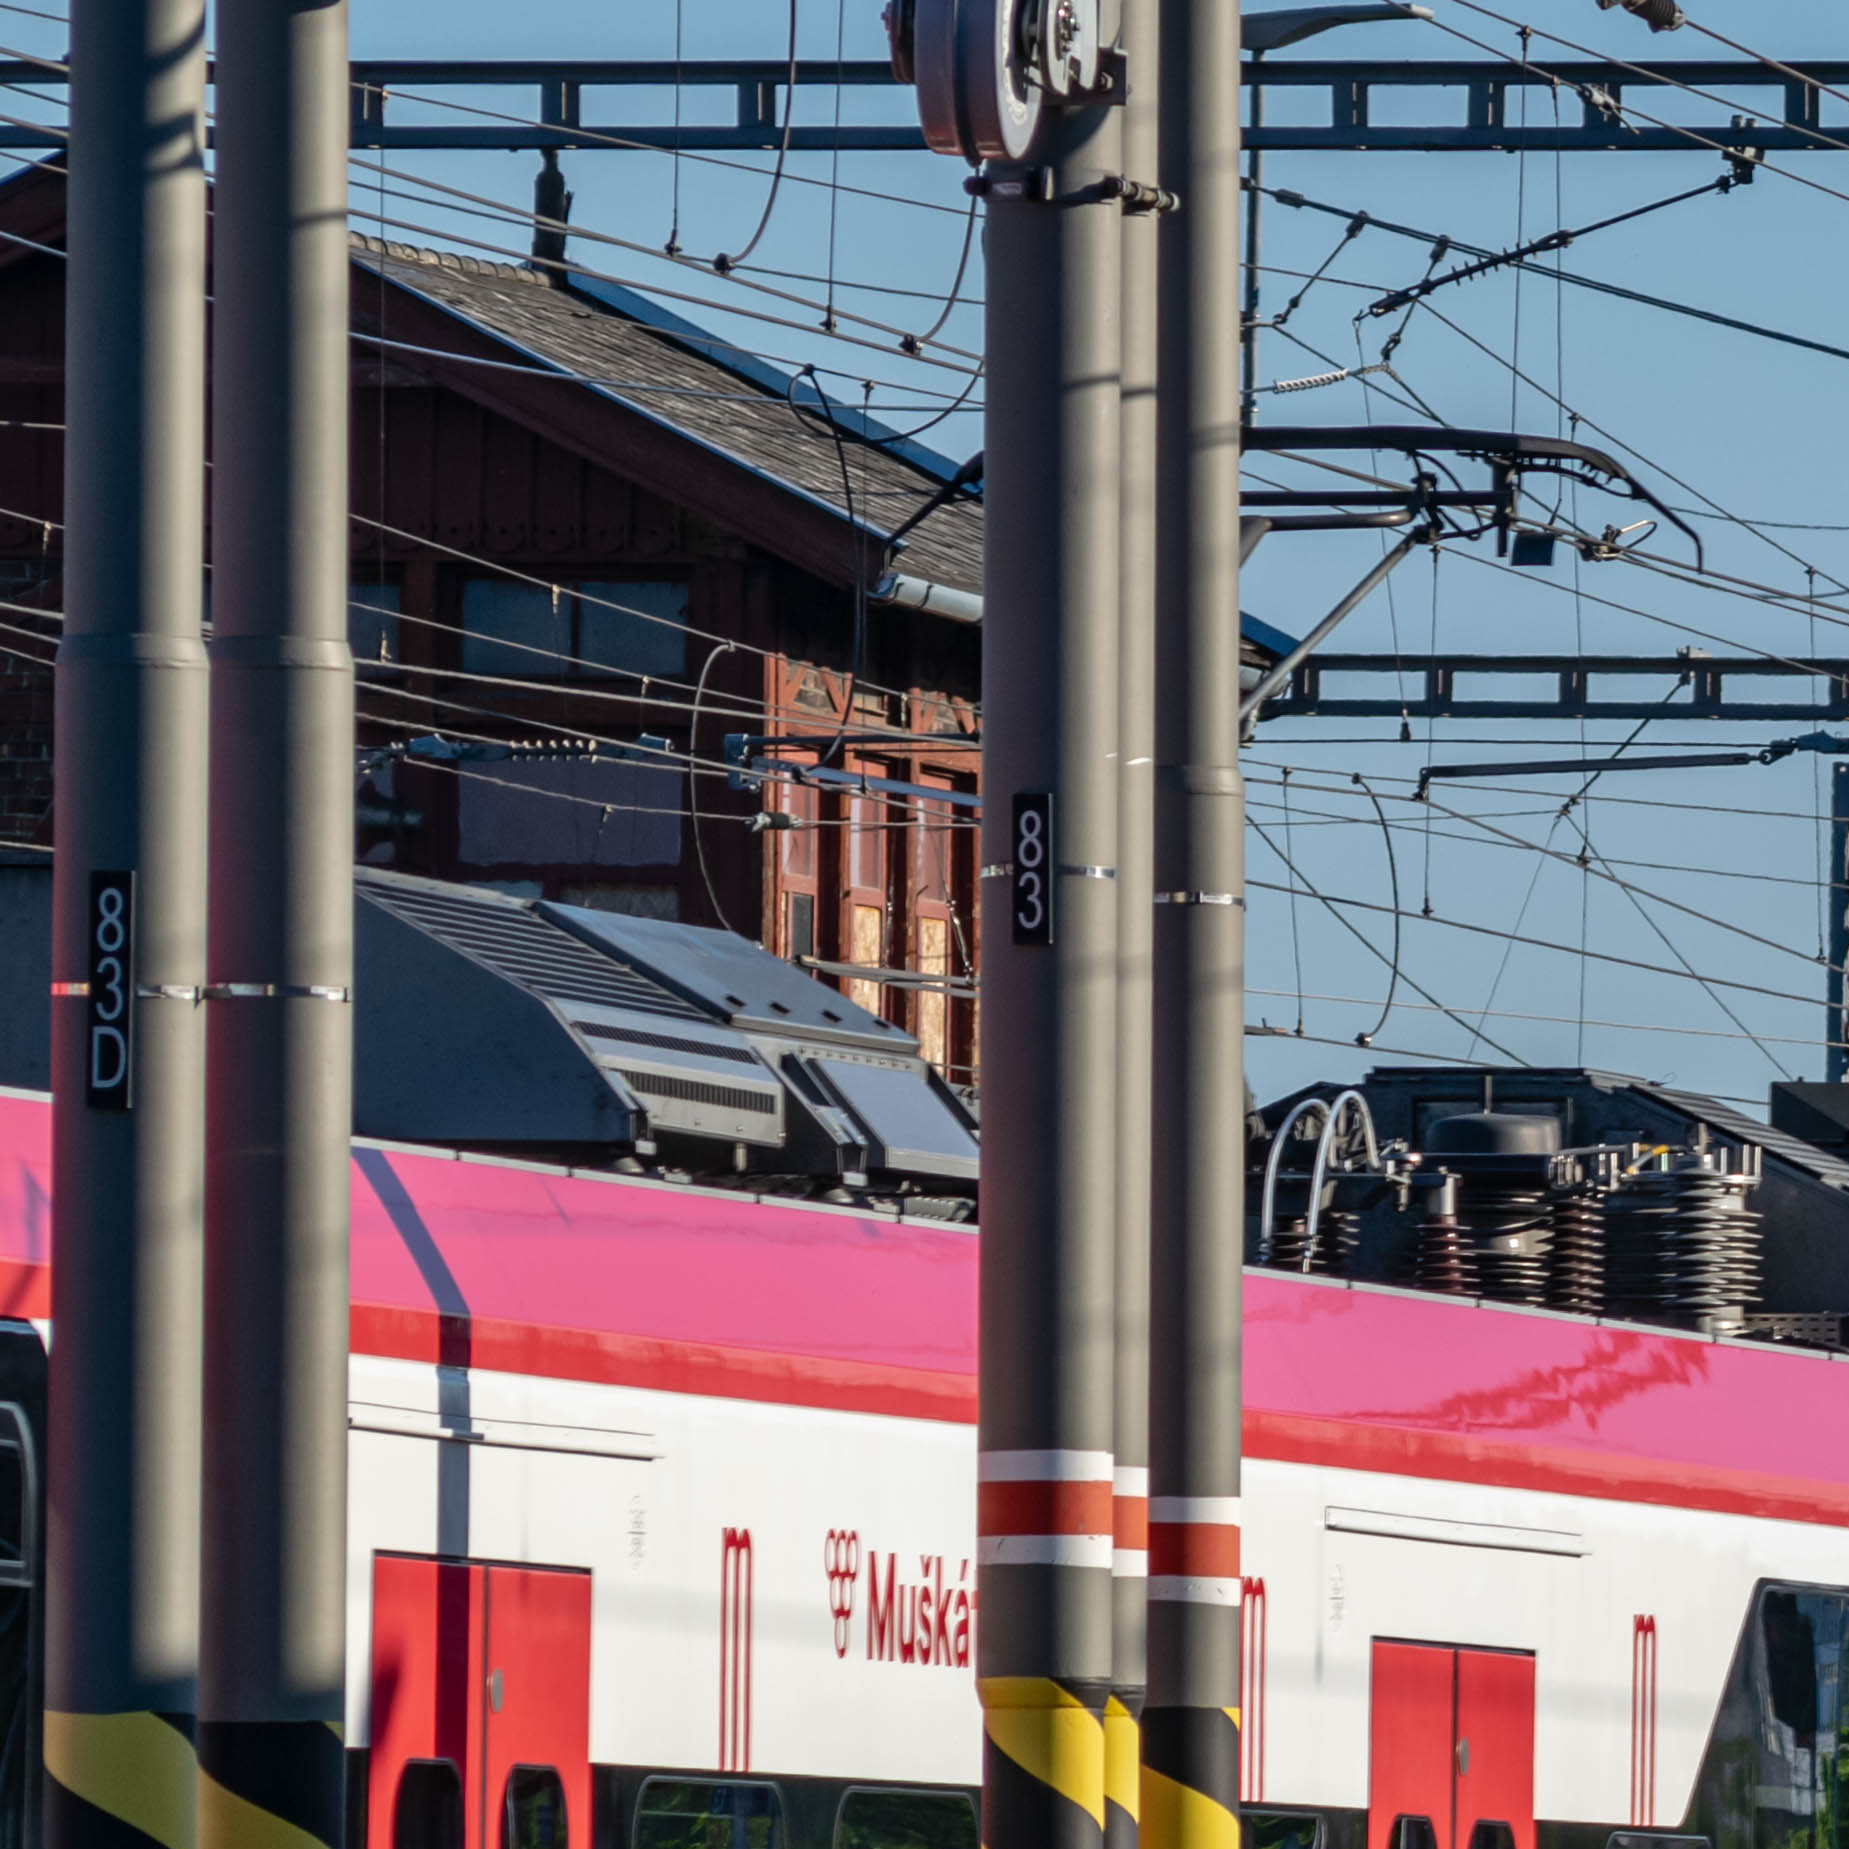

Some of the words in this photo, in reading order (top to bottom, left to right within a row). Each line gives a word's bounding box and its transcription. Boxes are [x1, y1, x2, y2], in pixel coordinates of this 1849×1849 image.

[1017, 809, 1043, 929] 83
[91, 887, 127, 1089] 83D
[866, 1550, 978, 1669] Mušká
